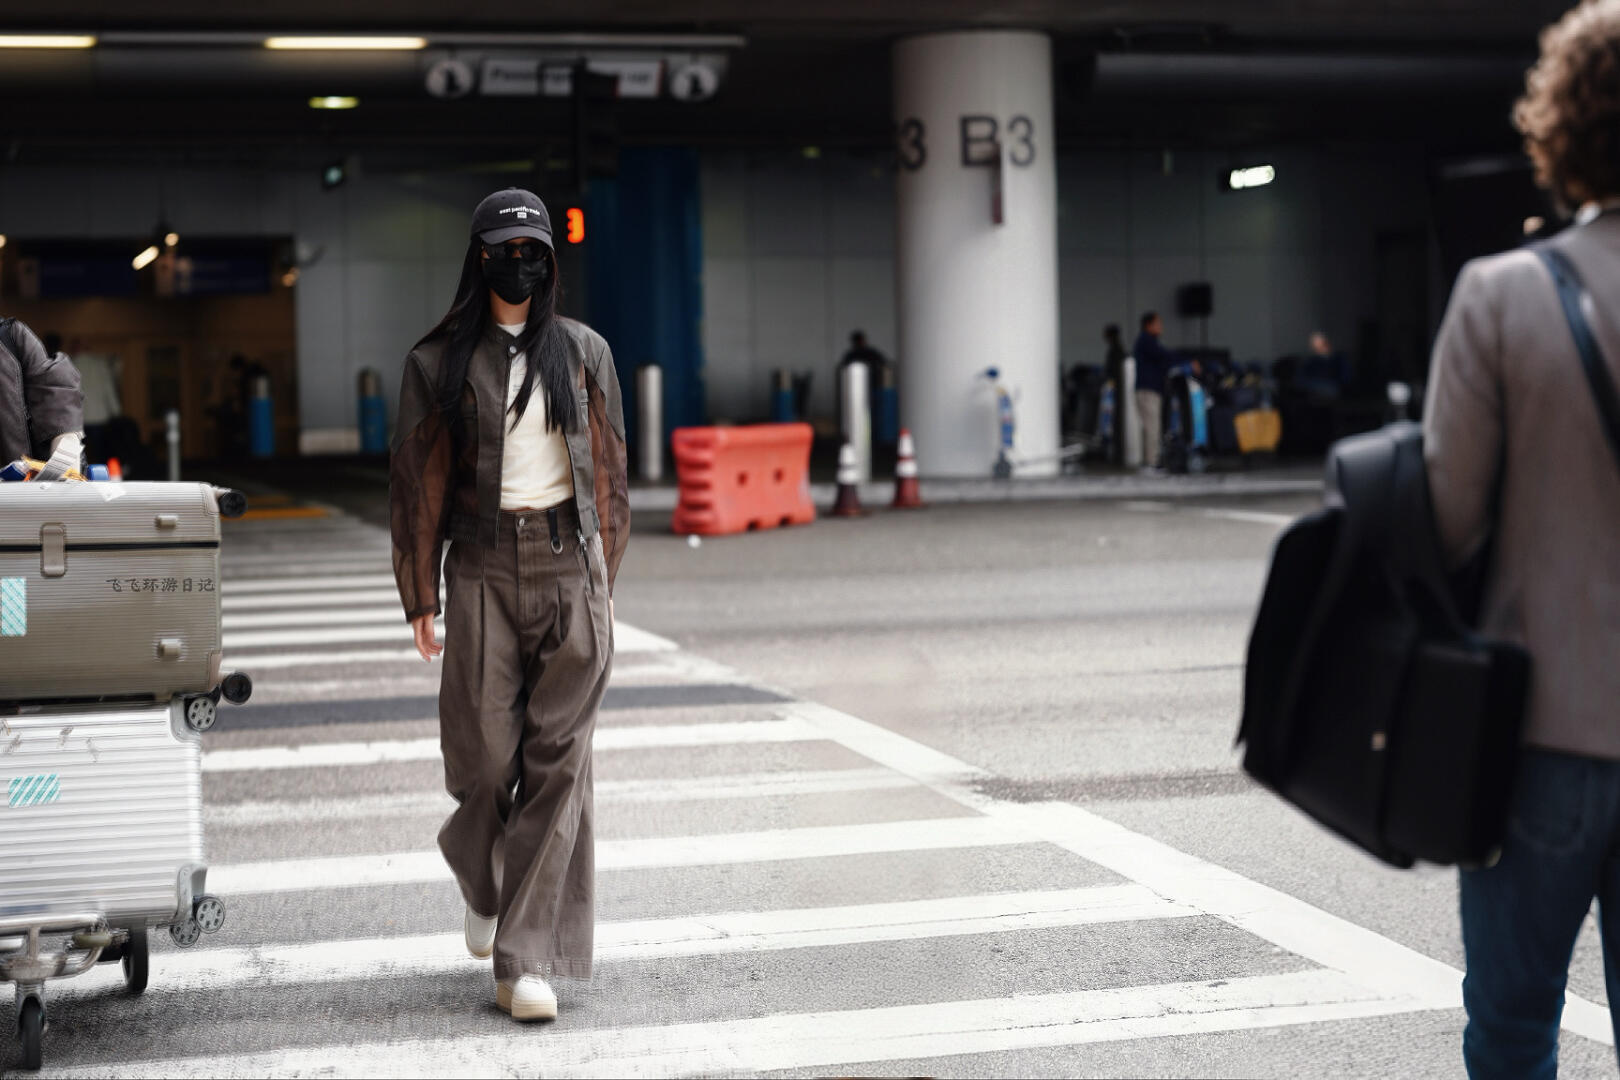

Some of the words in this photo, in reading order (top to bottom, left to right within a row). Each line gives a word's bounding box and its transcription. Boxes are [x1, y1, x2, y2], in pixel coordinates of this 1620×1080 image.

[958, 114, 1036, 168] B3
[566, 207, 585, 244] 3
[105, 578, 216, 593] 飞飞环游日记
